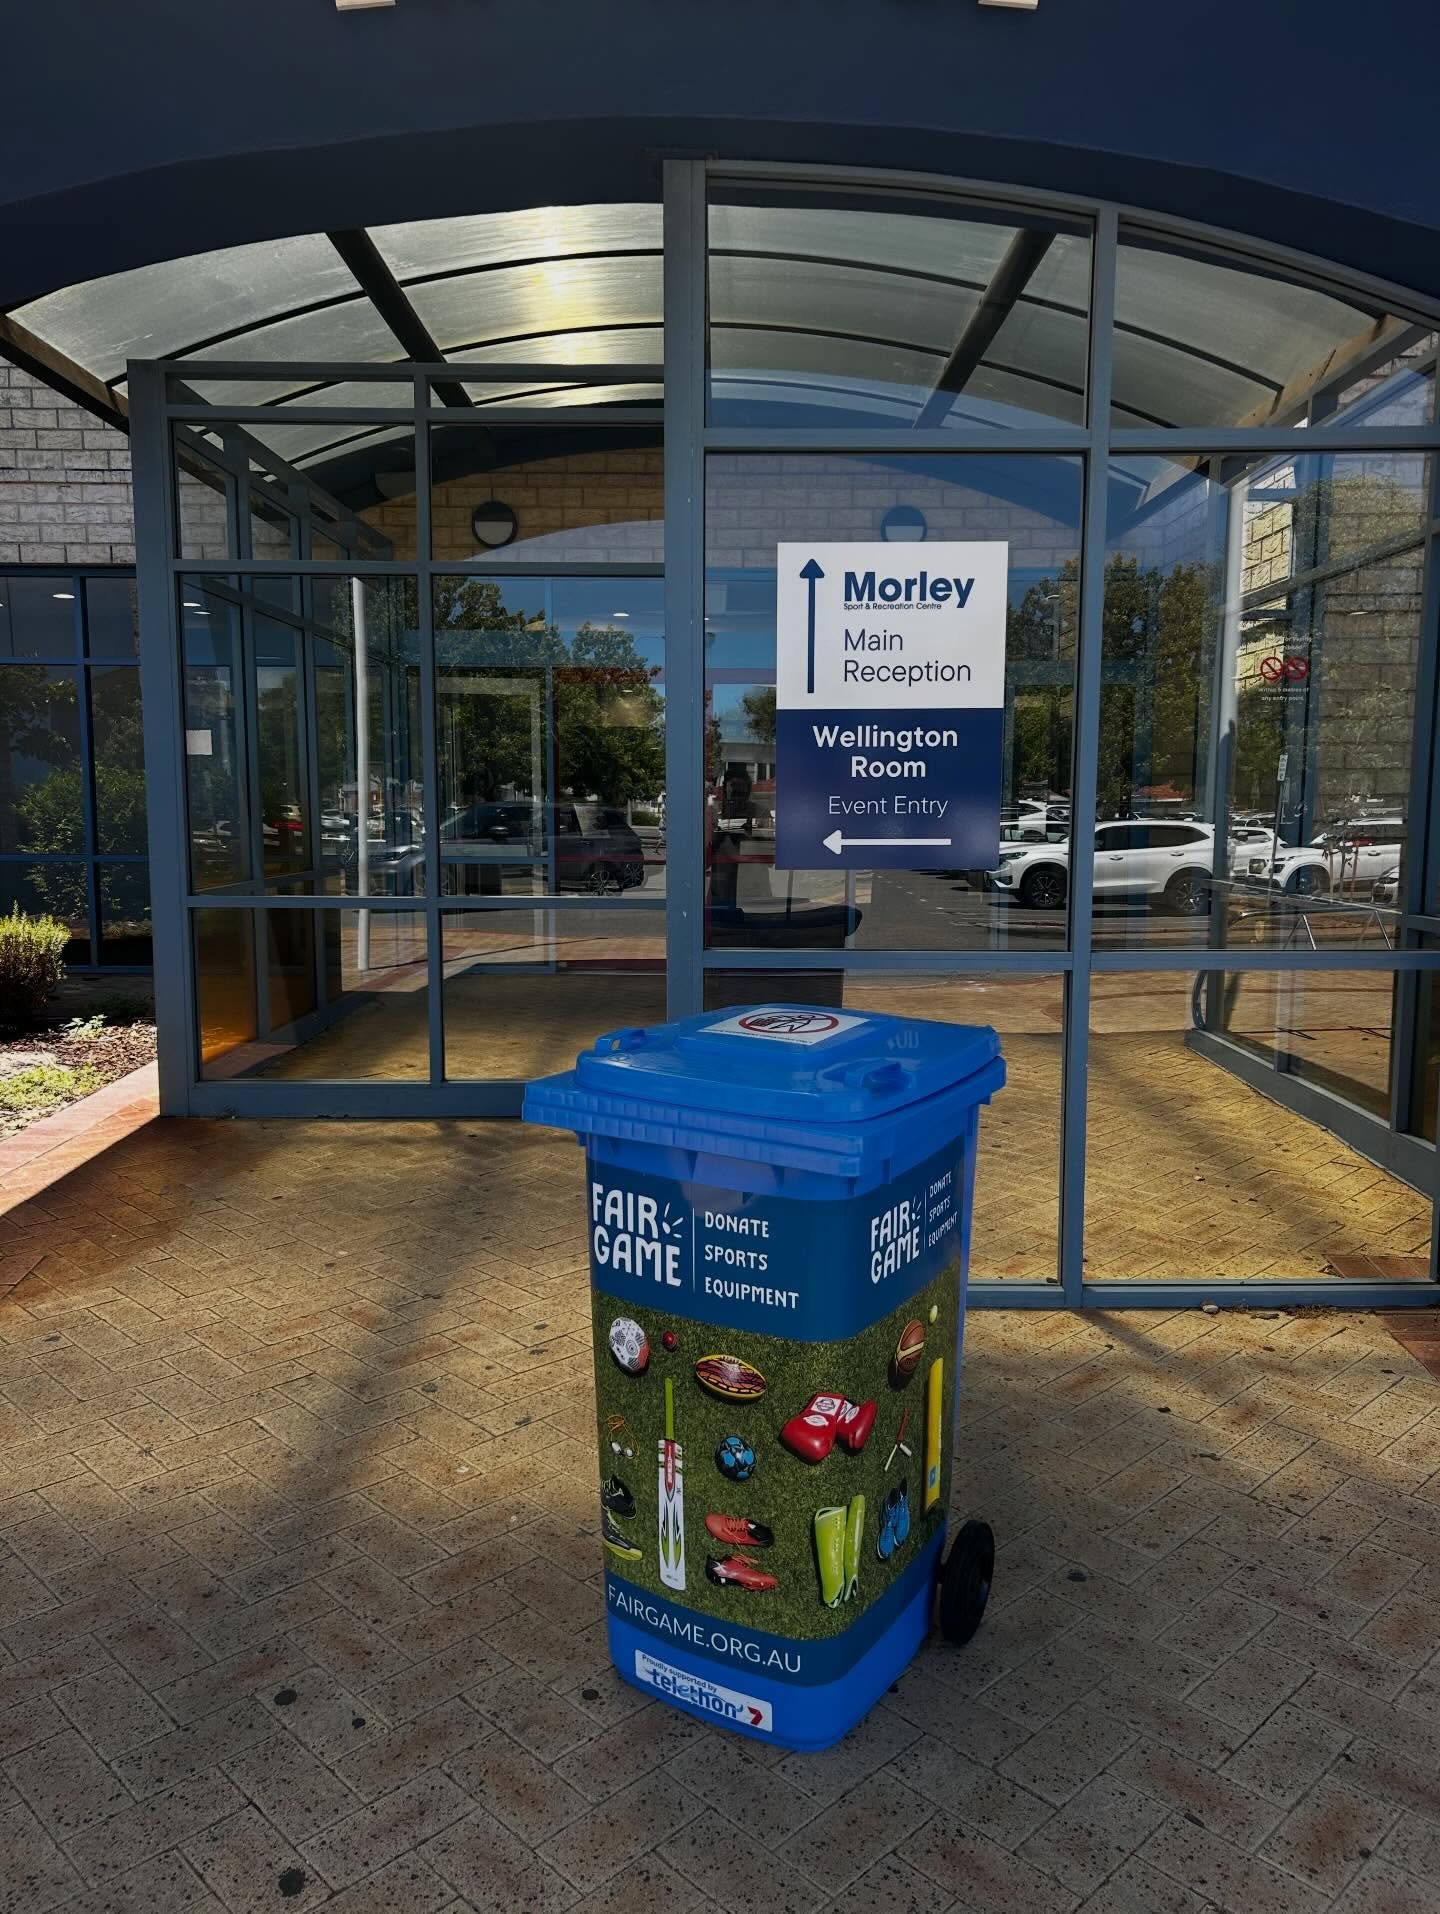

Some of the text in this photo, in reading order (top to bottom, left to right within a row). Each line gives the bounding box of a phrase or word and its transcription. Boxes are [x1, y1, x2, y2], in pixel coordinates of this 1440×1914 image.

[844, 571, 975, 609] Morley
[843, 602, 942, 611] Sport & Recreation Centre
[844, 628, 903, 651] Main
[843, 660, 971, 687] Reception
[812, 724, 958, 753] Wellington
[851, 755, 926, 778] Room
[829, 796, 948, 818] Event Entry
[929, 1171, 952, 1198] DONATE
[592, 1182, 659, 1239] FAIR
[929, 1195, 951, 1222] SPORTS
[704, 1211, 769, 1238] DONATE
[871, 1200, 910, 1252] FAIR
[928, 1211, 958, 1247] EQUIPMENT
[593, 1225, 682, 1287] GAME
[704, 1244, 769, 1271] SPORTS
[871, 1226, 920, 1284] GAME
[704, 1277, 799, 1309] EQUIPMENT
[608, 1583, 801, 1673] FAIRGAME.ORG.AU
[642, 1654, 717, 1693] Proudly supported by
[651, 1668, 737, 1719] telethon
